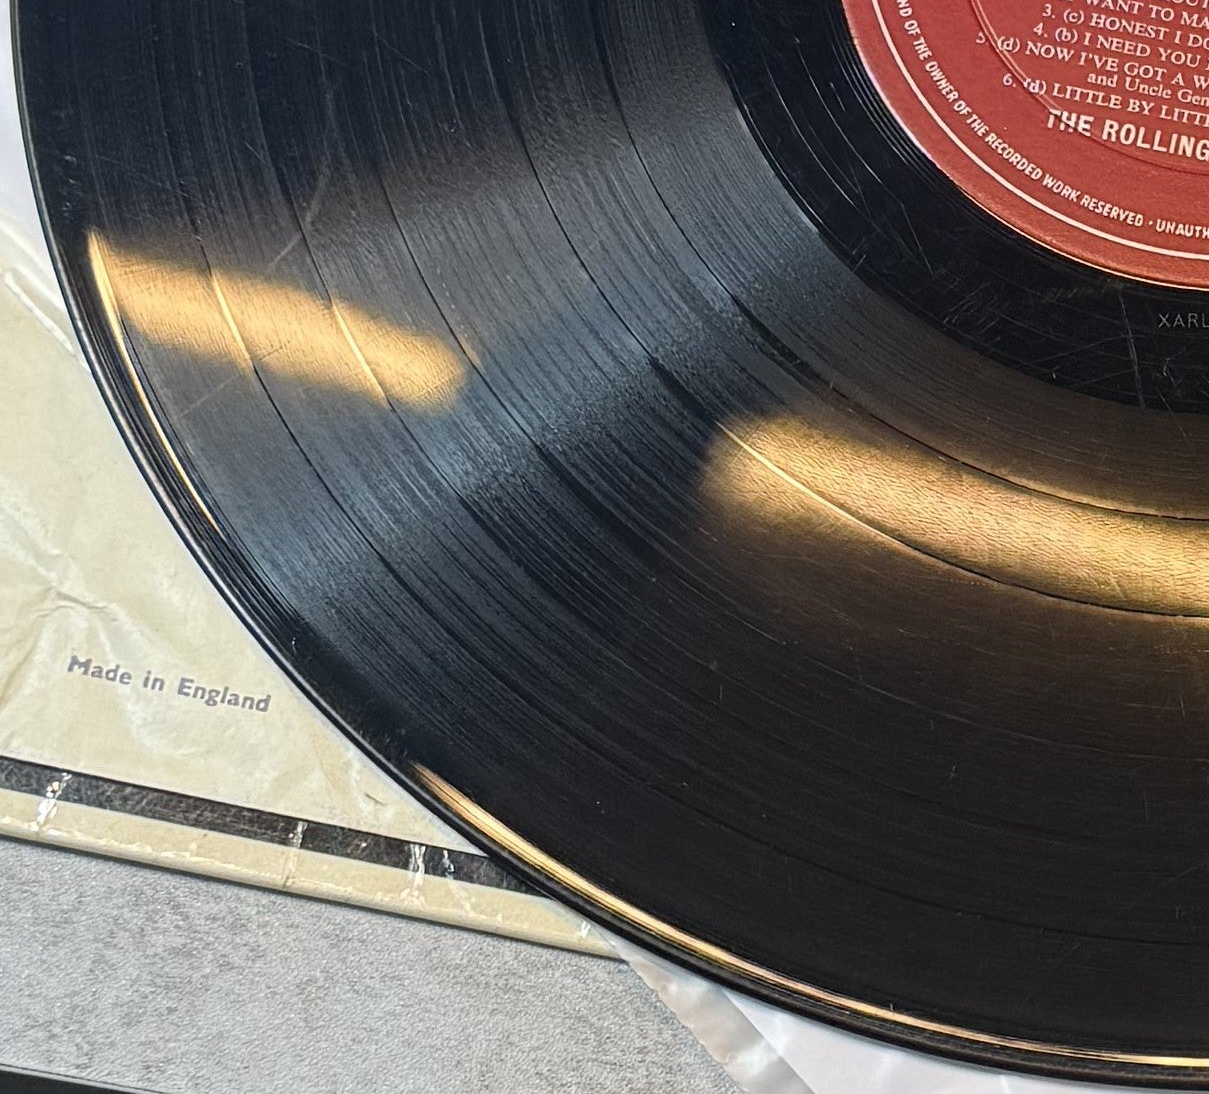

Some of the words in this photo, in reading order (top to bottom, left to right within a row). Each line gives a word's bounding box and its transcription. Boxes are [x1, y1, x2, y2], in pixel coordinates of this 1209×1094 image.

[1041, 4, 1056, 19] 3.
[1063, 9, 1085, 25] (c)
[1089, 13, 1170, 41] HONEST
[1174, 30, 1182, 44] I
[1148, 4, 1175, 22] TO
[997, 36, 1021, 54] (d)
[1025, 41, 1074, 61] NOW
[1079, 52, 1119, 72] I'VE
[1123, 61, 1167, 82] GOT
[1171, 72, 1186, 86] A
[1033, 23, 1048, 38] 4.
[1055, 27, 1078, 44] (b)
[1083, 32, 1092, 46] I
[1097, 35, 1151, 58] NEED
[1158, 47, 1201, 68] YOU
[1002, 74, 1016, 87] 6.
[1052, 83, 1122, 110] LITTLE
[1127, 98, 1155, 115] BY
[1087, 73, 1118, 88] and
[1125, 77, 1172, 99] Uncle
[904, 20, 921, 36] OF
[913, 36, 933, 61] THE
[925, 61, 959, 103] OWNER
[953, 100, 973, 116] OF
[966, 114, 989, 138] THE
[985, 132, 1042, 180] RECORDED
[1042, 173, 1081, 203] WORK
[1080, 195, 1144, 227] RESERVED
[1047, 108, 1094, 137] THE
[67, 655, 133, 685] Made
[142, 670, 165, 691] in
[177, 677, 272, 713] England
